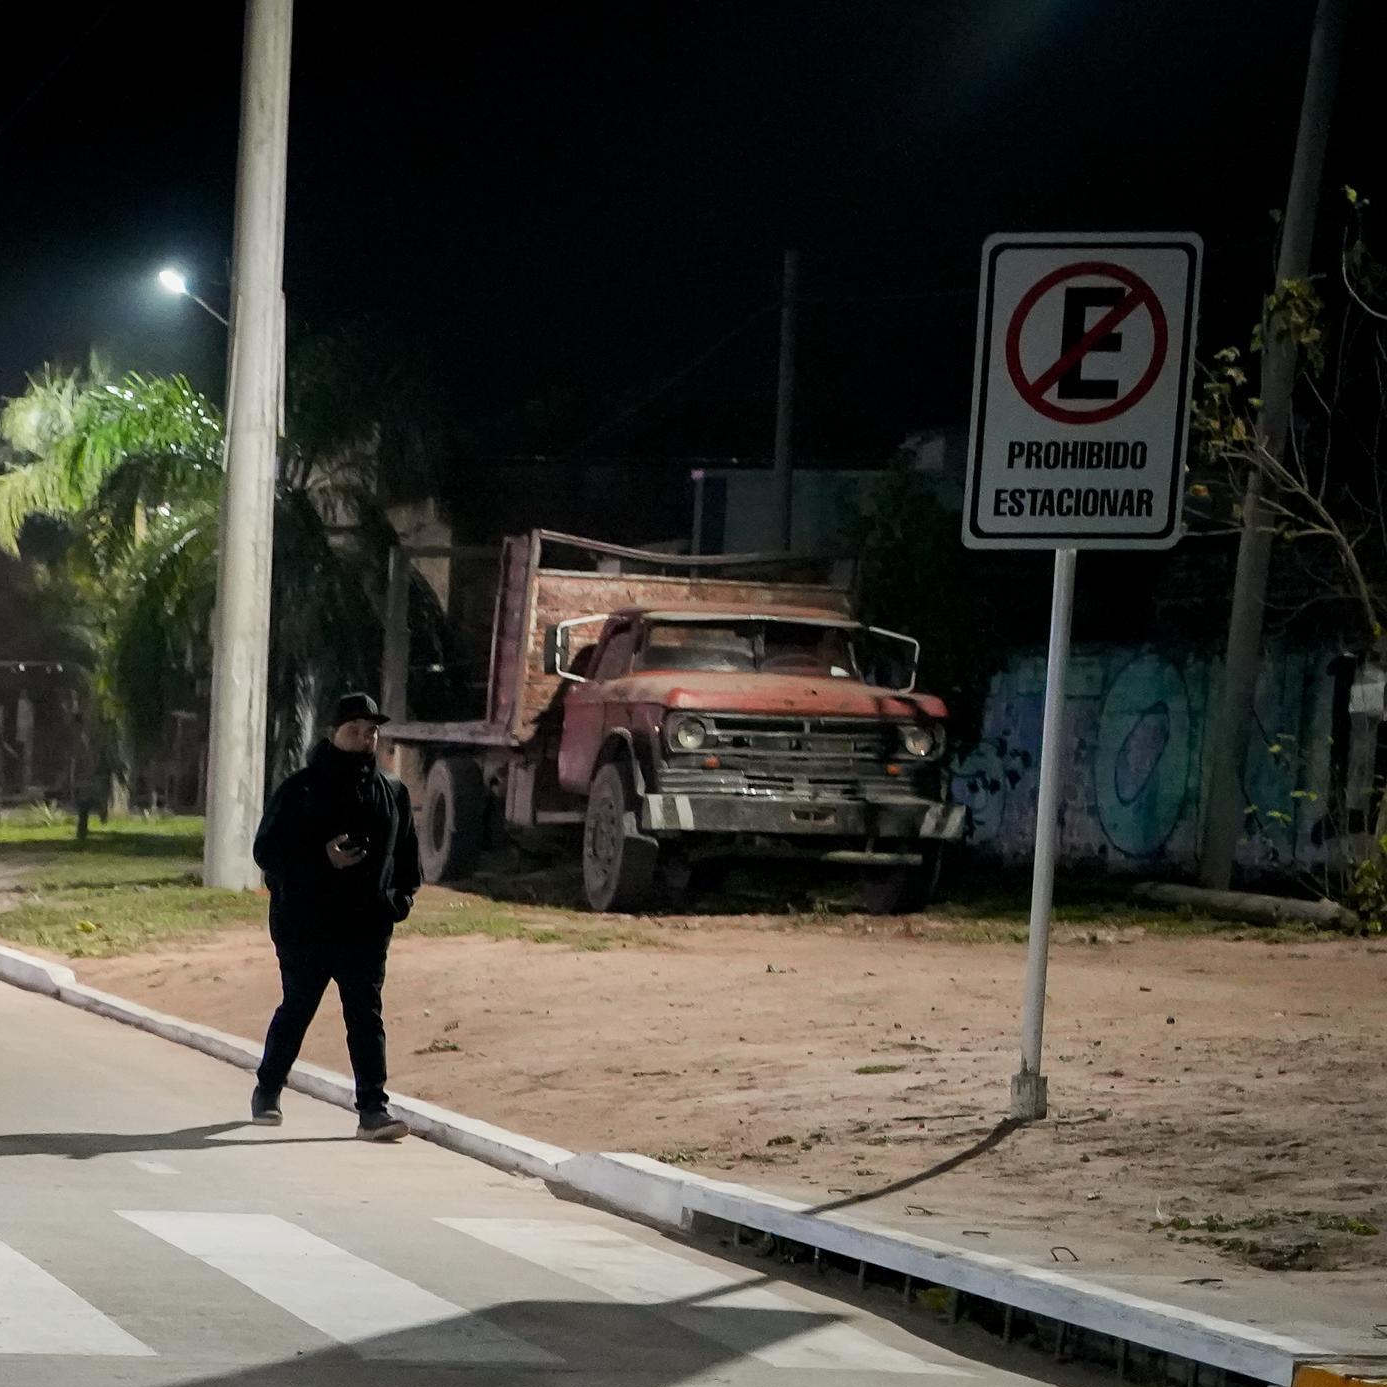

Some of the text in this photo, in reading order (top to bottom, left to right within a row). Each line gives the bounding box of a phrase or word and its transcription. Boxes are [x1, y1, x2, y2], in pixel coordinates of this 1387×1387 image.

[1057, 286, 1125, 399] E
[1007, 441, 1148, 469] PROHIBIDO
[993, 488, 1153, 517] ESTACIONAR
